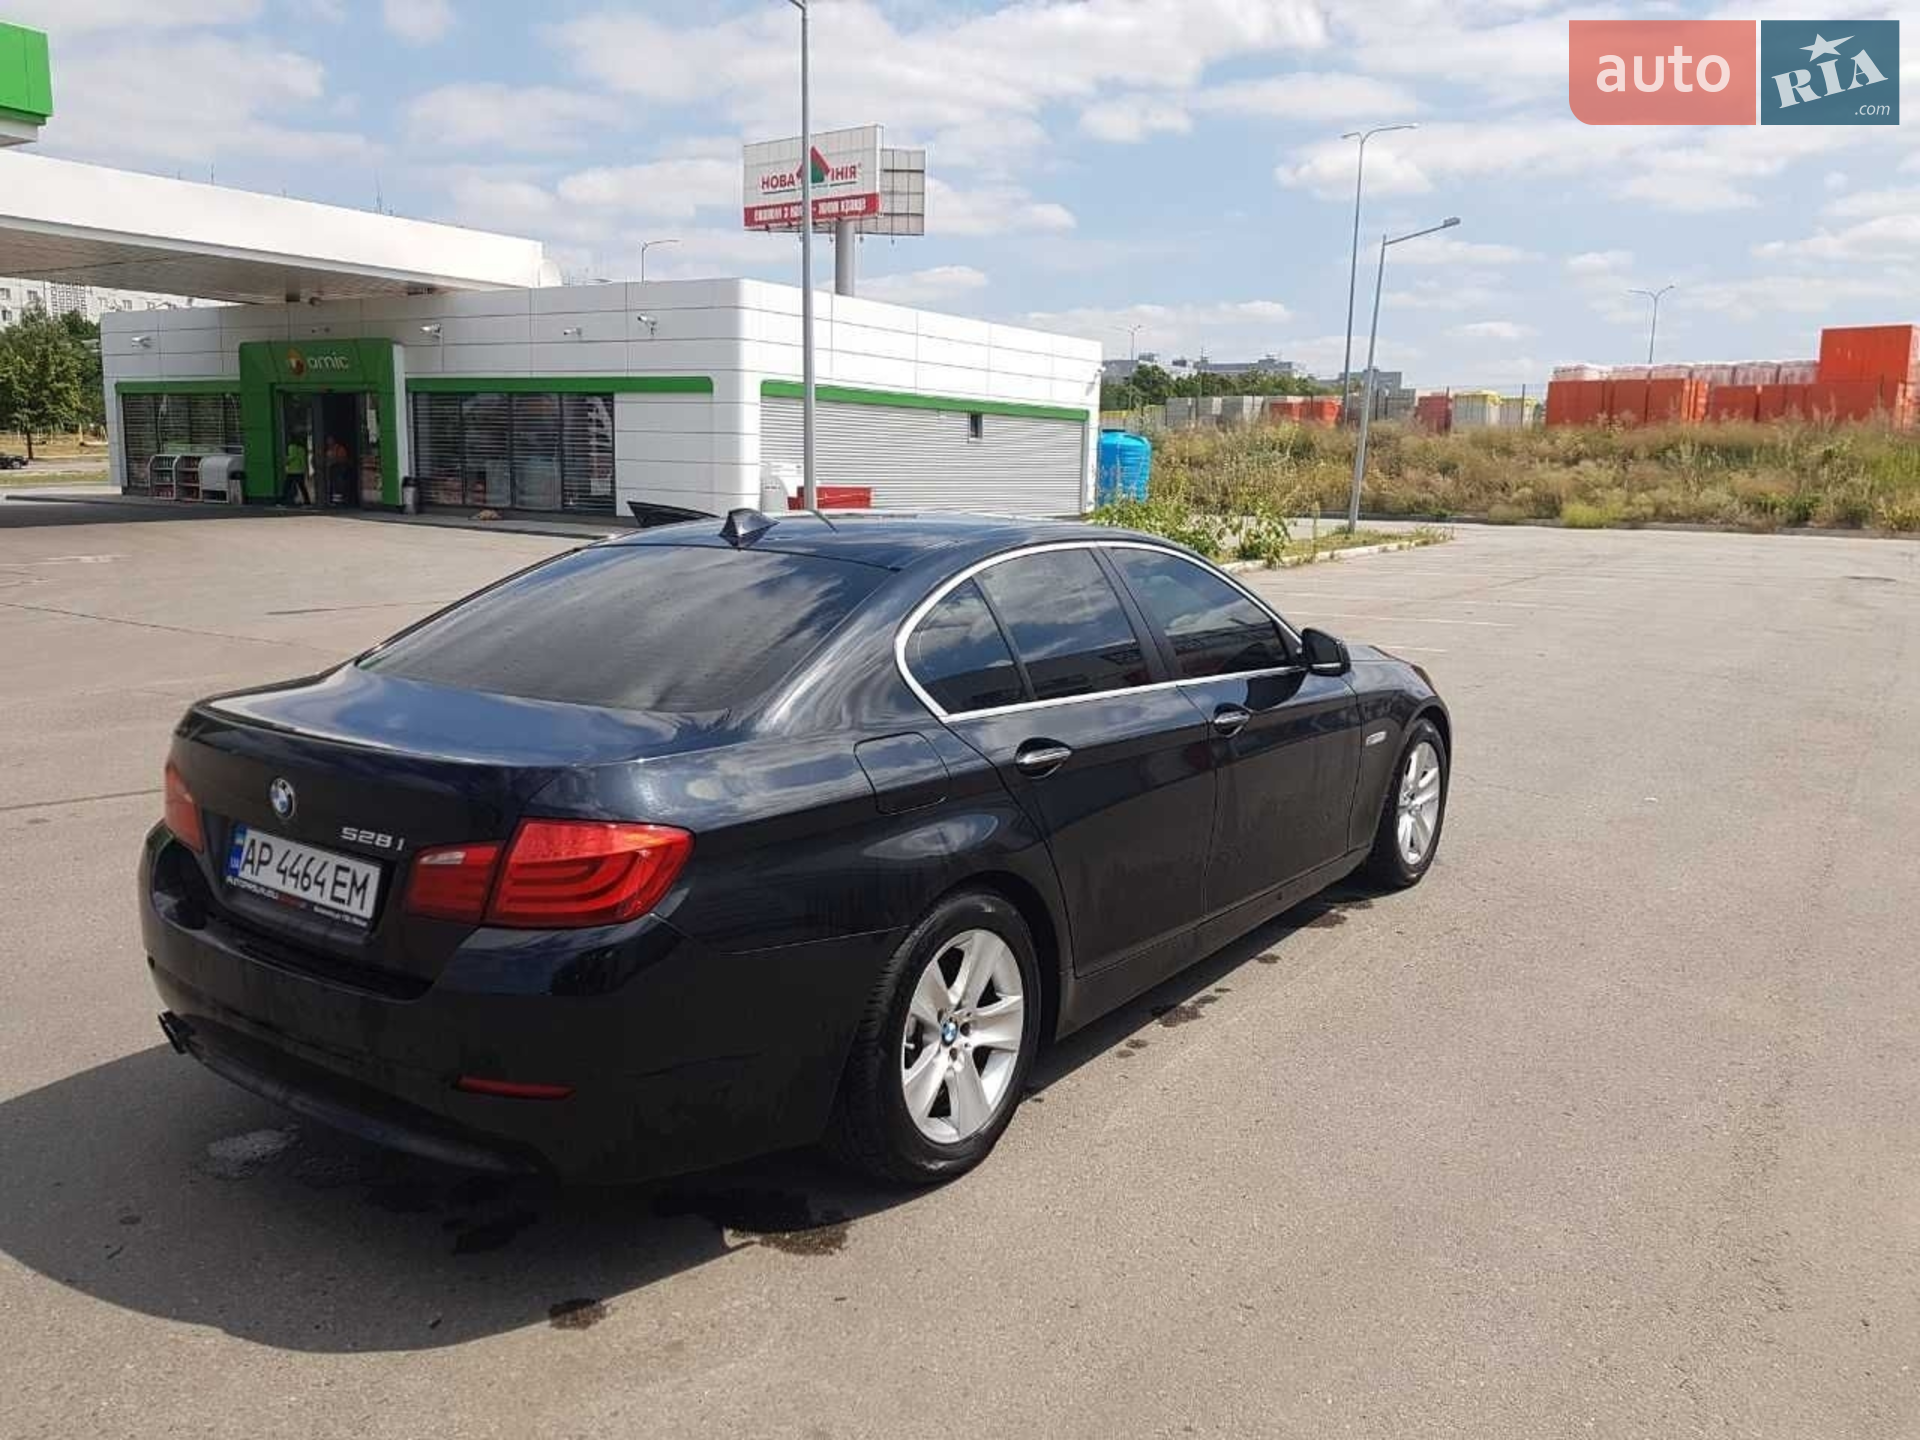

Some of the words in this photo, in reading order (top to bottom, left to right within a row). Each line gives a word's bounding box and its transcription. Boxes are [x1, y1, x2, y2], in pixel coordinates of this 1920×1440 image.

[761, 174, 796, 190] НОВА
[307, 352, 350, 370] amic
[241, 838, 273, 876] AP
[276, 849, 328, 898] 4464
[330, 863, 371, 911] EM
